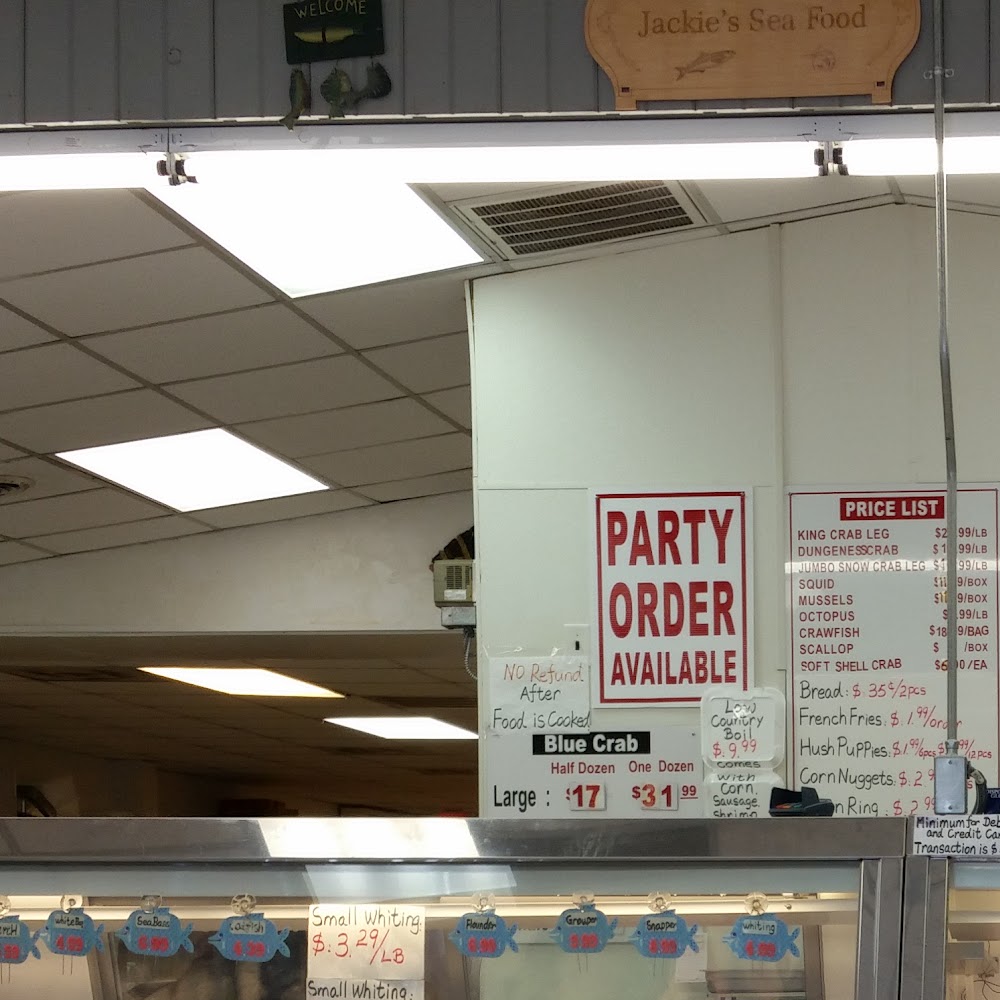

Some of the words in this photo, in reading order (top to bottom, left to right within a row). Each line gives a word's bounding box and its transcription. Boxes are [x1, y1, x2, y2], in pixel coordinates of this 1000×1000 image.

[294, 0, 367, 18] WELCOME
[637, 6, 740, 38] Jackie's
[749, 4, 796, 31] Sea
[806, 4, 867, 30] Food
[846, 501, 896, 517] PRICE
[902, 499, 938, 516] LIST
[607, 509, 734, 566] PARTY
[798, 529, 826, 541] KING
[830, 529, 863, 540] CRAB
[867, 528, 890, 540] LEG
[799, 562, 835, 574] JUMBO
[838, 562, 869, 573] SNOW
[873, 561, 902, 572] CRAB
[905, 560, 926, 572] LEG
[798, 579, 835, 590] SQUID
[798, 594, 854, 606] MUSSELS
[609, 580, 736, 638] ORDER
[799, 611, 855, 622] OCTOPUS
[799, 627, 860, 639] CRAWFISH
[799, 643, 854, 655] SCALLOP
[610, 650, 737, 685] AVAILABLE
[801, 661, 830, 672] SOFT
[835, 660, 868, 672] SHELL
[872, 658, 902, 670] CRAB
[503, 664, 525, 681] NO
[530, 663, 584, 684] Refund
[520, 683, 561, 702] After
[799, 680, 849, 700] Bread:
[725, 700, 757, 714] Low
[493, 708, 527, 730] Food
[533, 713, 545, 729] is
[711, 714, 764, 729] Country
[799, 706, 847, 727] French
[724, 727, 752, 741] Boil
[544, 734, 586, 753] Blue
[592, 734, 639, 753] Crab
[799, 737, 835, 757] Hush
[551, 761, 575, 775] Half
[578, 761, 615, 775] Dozen
[629, 760, 652, 774] One
[658, 760, 694, 773] Dozen
[716, 761, 761, 769] comes
[717, 773, 755, 782] with
[799, 767, 836, 785] Corn
[494, 785, 537, 813] Large
[916, 816, 968, 829] Minimum
[967, 816, 980, 830] for
[926, 829, 947, 839] and
[948, 828, 983, 840] Credit
[914, 841, 976, 855] Transaction
[979, 842, 988, 854] is
[312, 906, 357, 927] Small
[466, 918, 497, 931] Flounder
[646, 919, 677, 932] Snapper
[307, 981, 348, 999] Small
